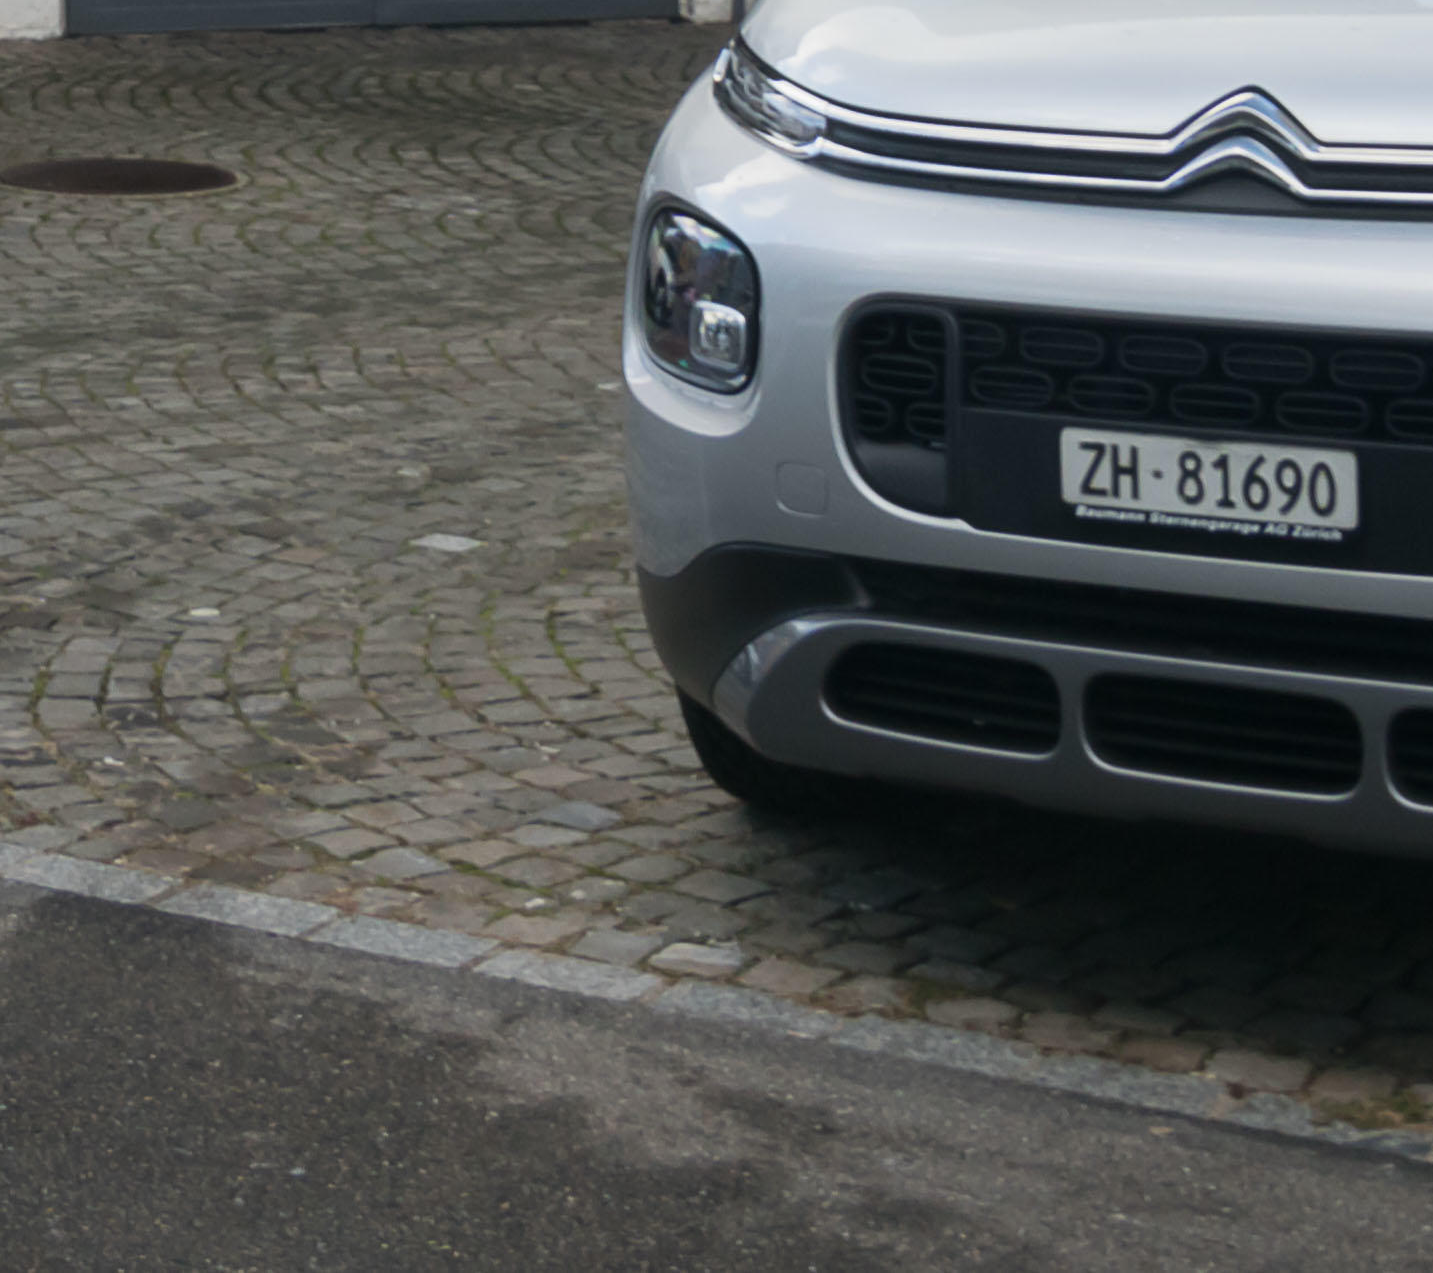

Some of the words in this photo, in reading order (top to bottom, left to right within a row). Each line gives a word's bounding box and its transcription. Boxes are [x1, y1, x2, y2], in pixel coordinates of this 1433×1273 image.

[1074, 503, 1147, 523] Baumann
[1148, 511, 1261, 535] Sternengarage
[1263, 522, 1289, 537] AG
[1290, 524, 1343, 542] Zürich
